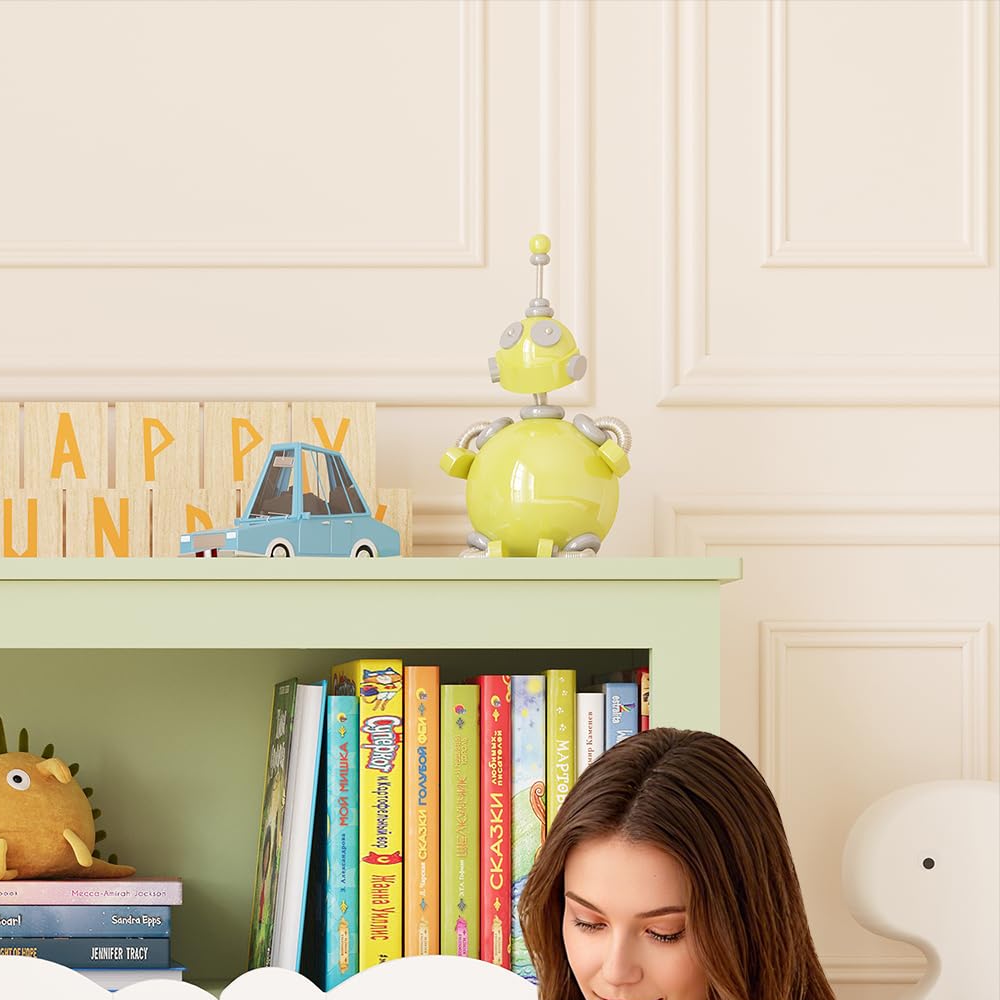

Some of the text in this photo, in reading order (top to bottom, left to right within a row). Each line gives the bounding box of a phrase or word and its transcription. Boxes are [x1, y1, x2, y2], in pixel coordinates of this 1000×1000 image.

[362, 715, 402, 773] Суперкот
[338, 741, 349, 827] МОЙ МИШКА
[416, 746, 428, 806] ГОЛУБОЙ
[556, 740, 570, 811] МАРТОВ
[371, 781, 392, 836] Картофельный
[417, 809, 428, 860] СКАЗКИ
[371, 836, 388, 849] вор
[490, 793, 503, 890] СКАЗКИ
[371, 874, 396, 905] Жанна
[111, 915, 162, 927] Sandra Epps
[370, 907, 395, 941] Уиллис
[90, 947, 149, 960] JENNIFER TRACY
